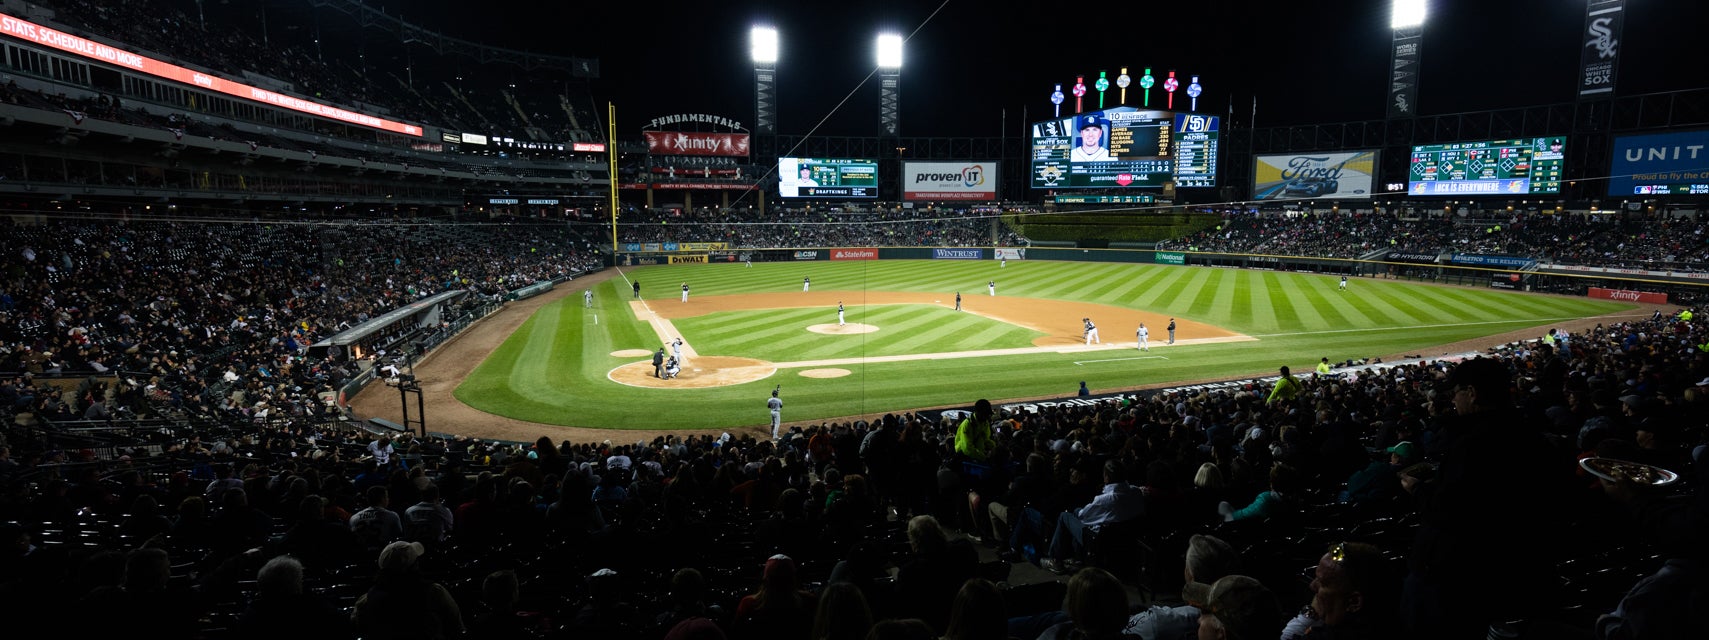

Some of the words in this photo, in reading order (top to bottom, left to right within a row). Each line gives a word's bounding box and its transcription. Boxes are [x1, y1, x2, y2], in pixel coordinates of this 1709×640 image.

[2, 17, 38, 41] STATS,
[39, 28, 94, 55] SCHEDULE
[96, 46, 116, 61] AND
[117, 52, 143, 68] MORE
[1585, 74, 1610, 86] SOX
[652, 114, 741, 130] FUNDAMENTALS
[674, 135, 721, 152] xfinity
[1626, 145, 1704, 162] UNIT
[1281, 156, 1346, 180] Ford
[916, 172, 962, 183] proven
[968, 172, 979, 181] IT
[1435, 184, 1449, 192] LUCK
[1458, 182, 1499, 192] EVERYWHERE
[936, 250, 979, 259] WINTRUST
[1610, 291, 1641, 301] xfinity
